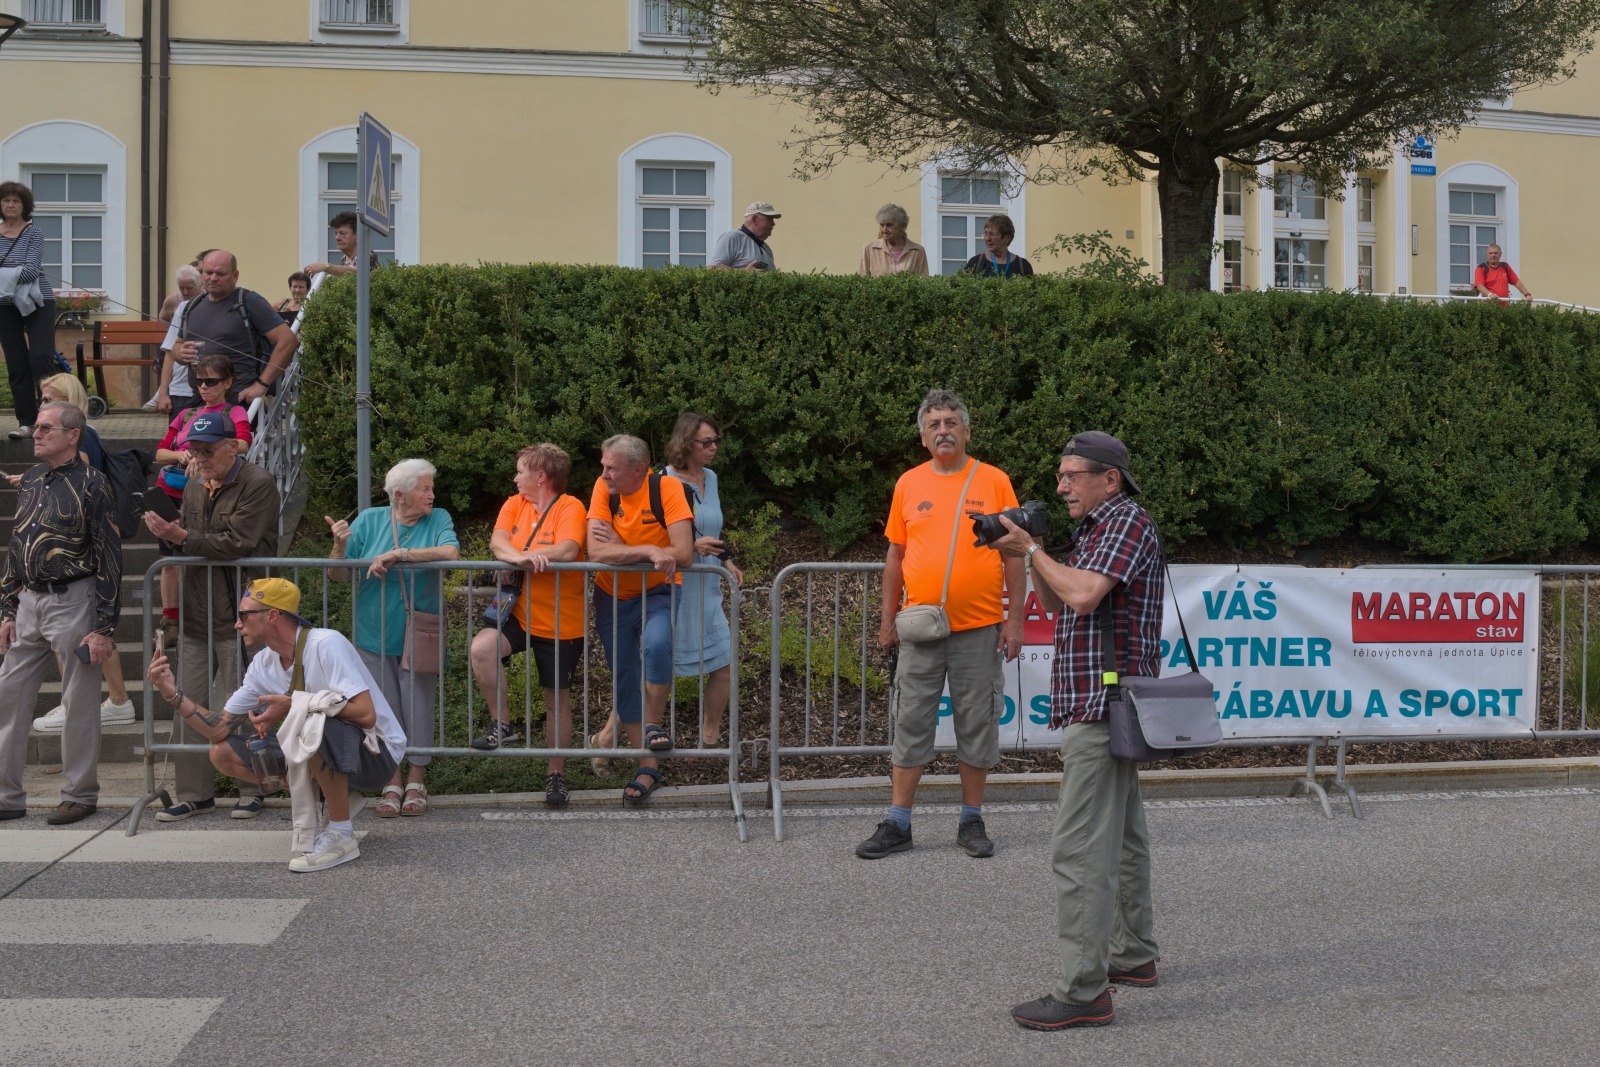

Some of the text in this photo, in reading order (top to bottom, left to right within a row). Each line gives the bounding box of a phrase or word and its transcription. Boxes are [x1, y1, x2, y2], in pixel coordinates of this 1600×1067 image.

[1202, 581, 1277, 620] VÁŠ
[1352, 592, 1525, 620] MARATON
[1476, 625, 1518, 638] stav
[1353, 646, 1523, 660] tělovýchovná jednota Úpice
[1363, 689, 1389, 718] A
[1399, 689, 1523, 718] SPORT
